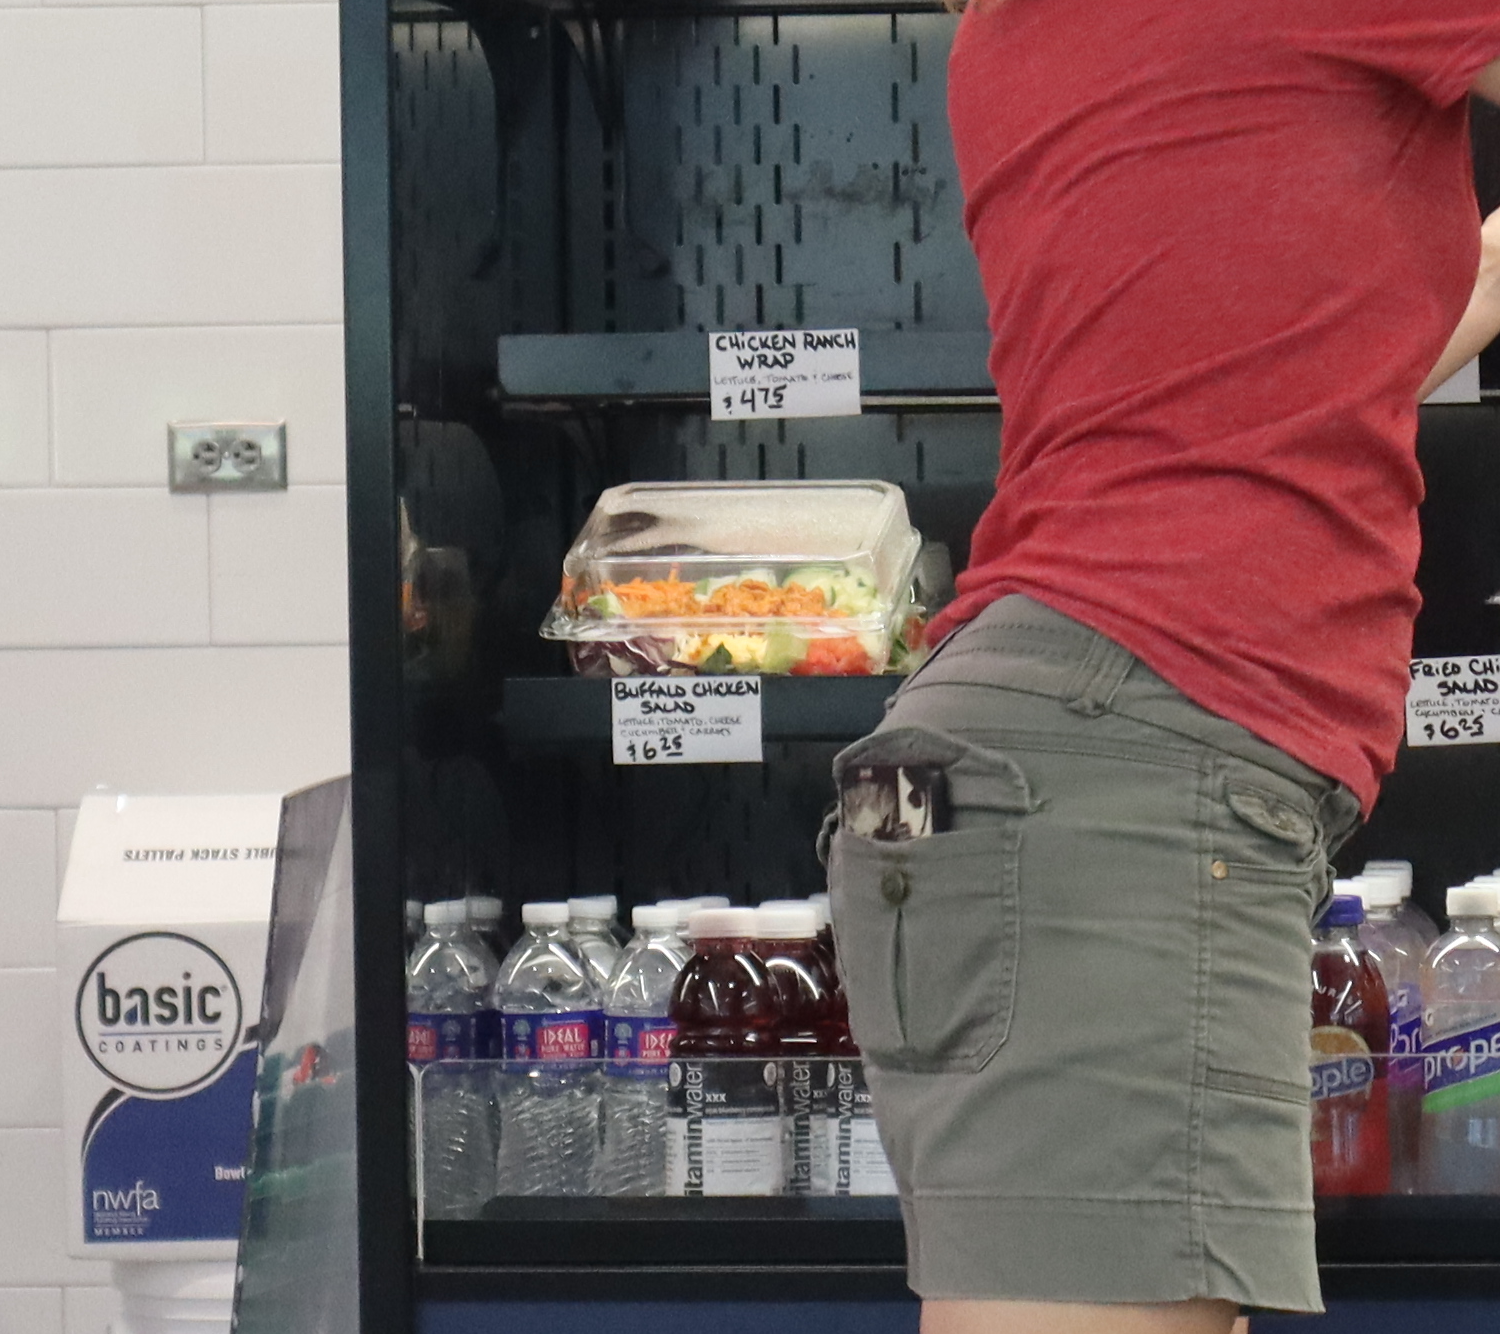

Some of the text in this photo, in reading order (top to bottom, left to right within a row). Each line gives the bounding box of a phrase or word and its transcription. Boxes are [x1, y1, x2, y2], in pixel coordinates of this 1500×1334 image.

[715, 332, 856, 352] CHICKEN RANCH
[736, 352, 795, 370] WRAP
[1408, 659, 1461, 680] FRIED
[614, 680, 760, 700] BUFFALO CHICKEN
[1437, 678, 1499, 697] SALAD
[640, 700, 695, 715] SALAD
[123, 849, 185, 862] PALLETS
[191, 848, 239, 861] STACK
[96, 972, 222, 1027] basic
[98, 1038, 223, 1053] COATINGS
[544, 1028, 582, 1044] IDEAL
[684, 1063, 703, 1196] itaminwater
[790, 1062, 811, 1196] itaminwater
[836, 1063, 853, 1196] itaminwater
[92, 1180, 160, 1216] nwfa
